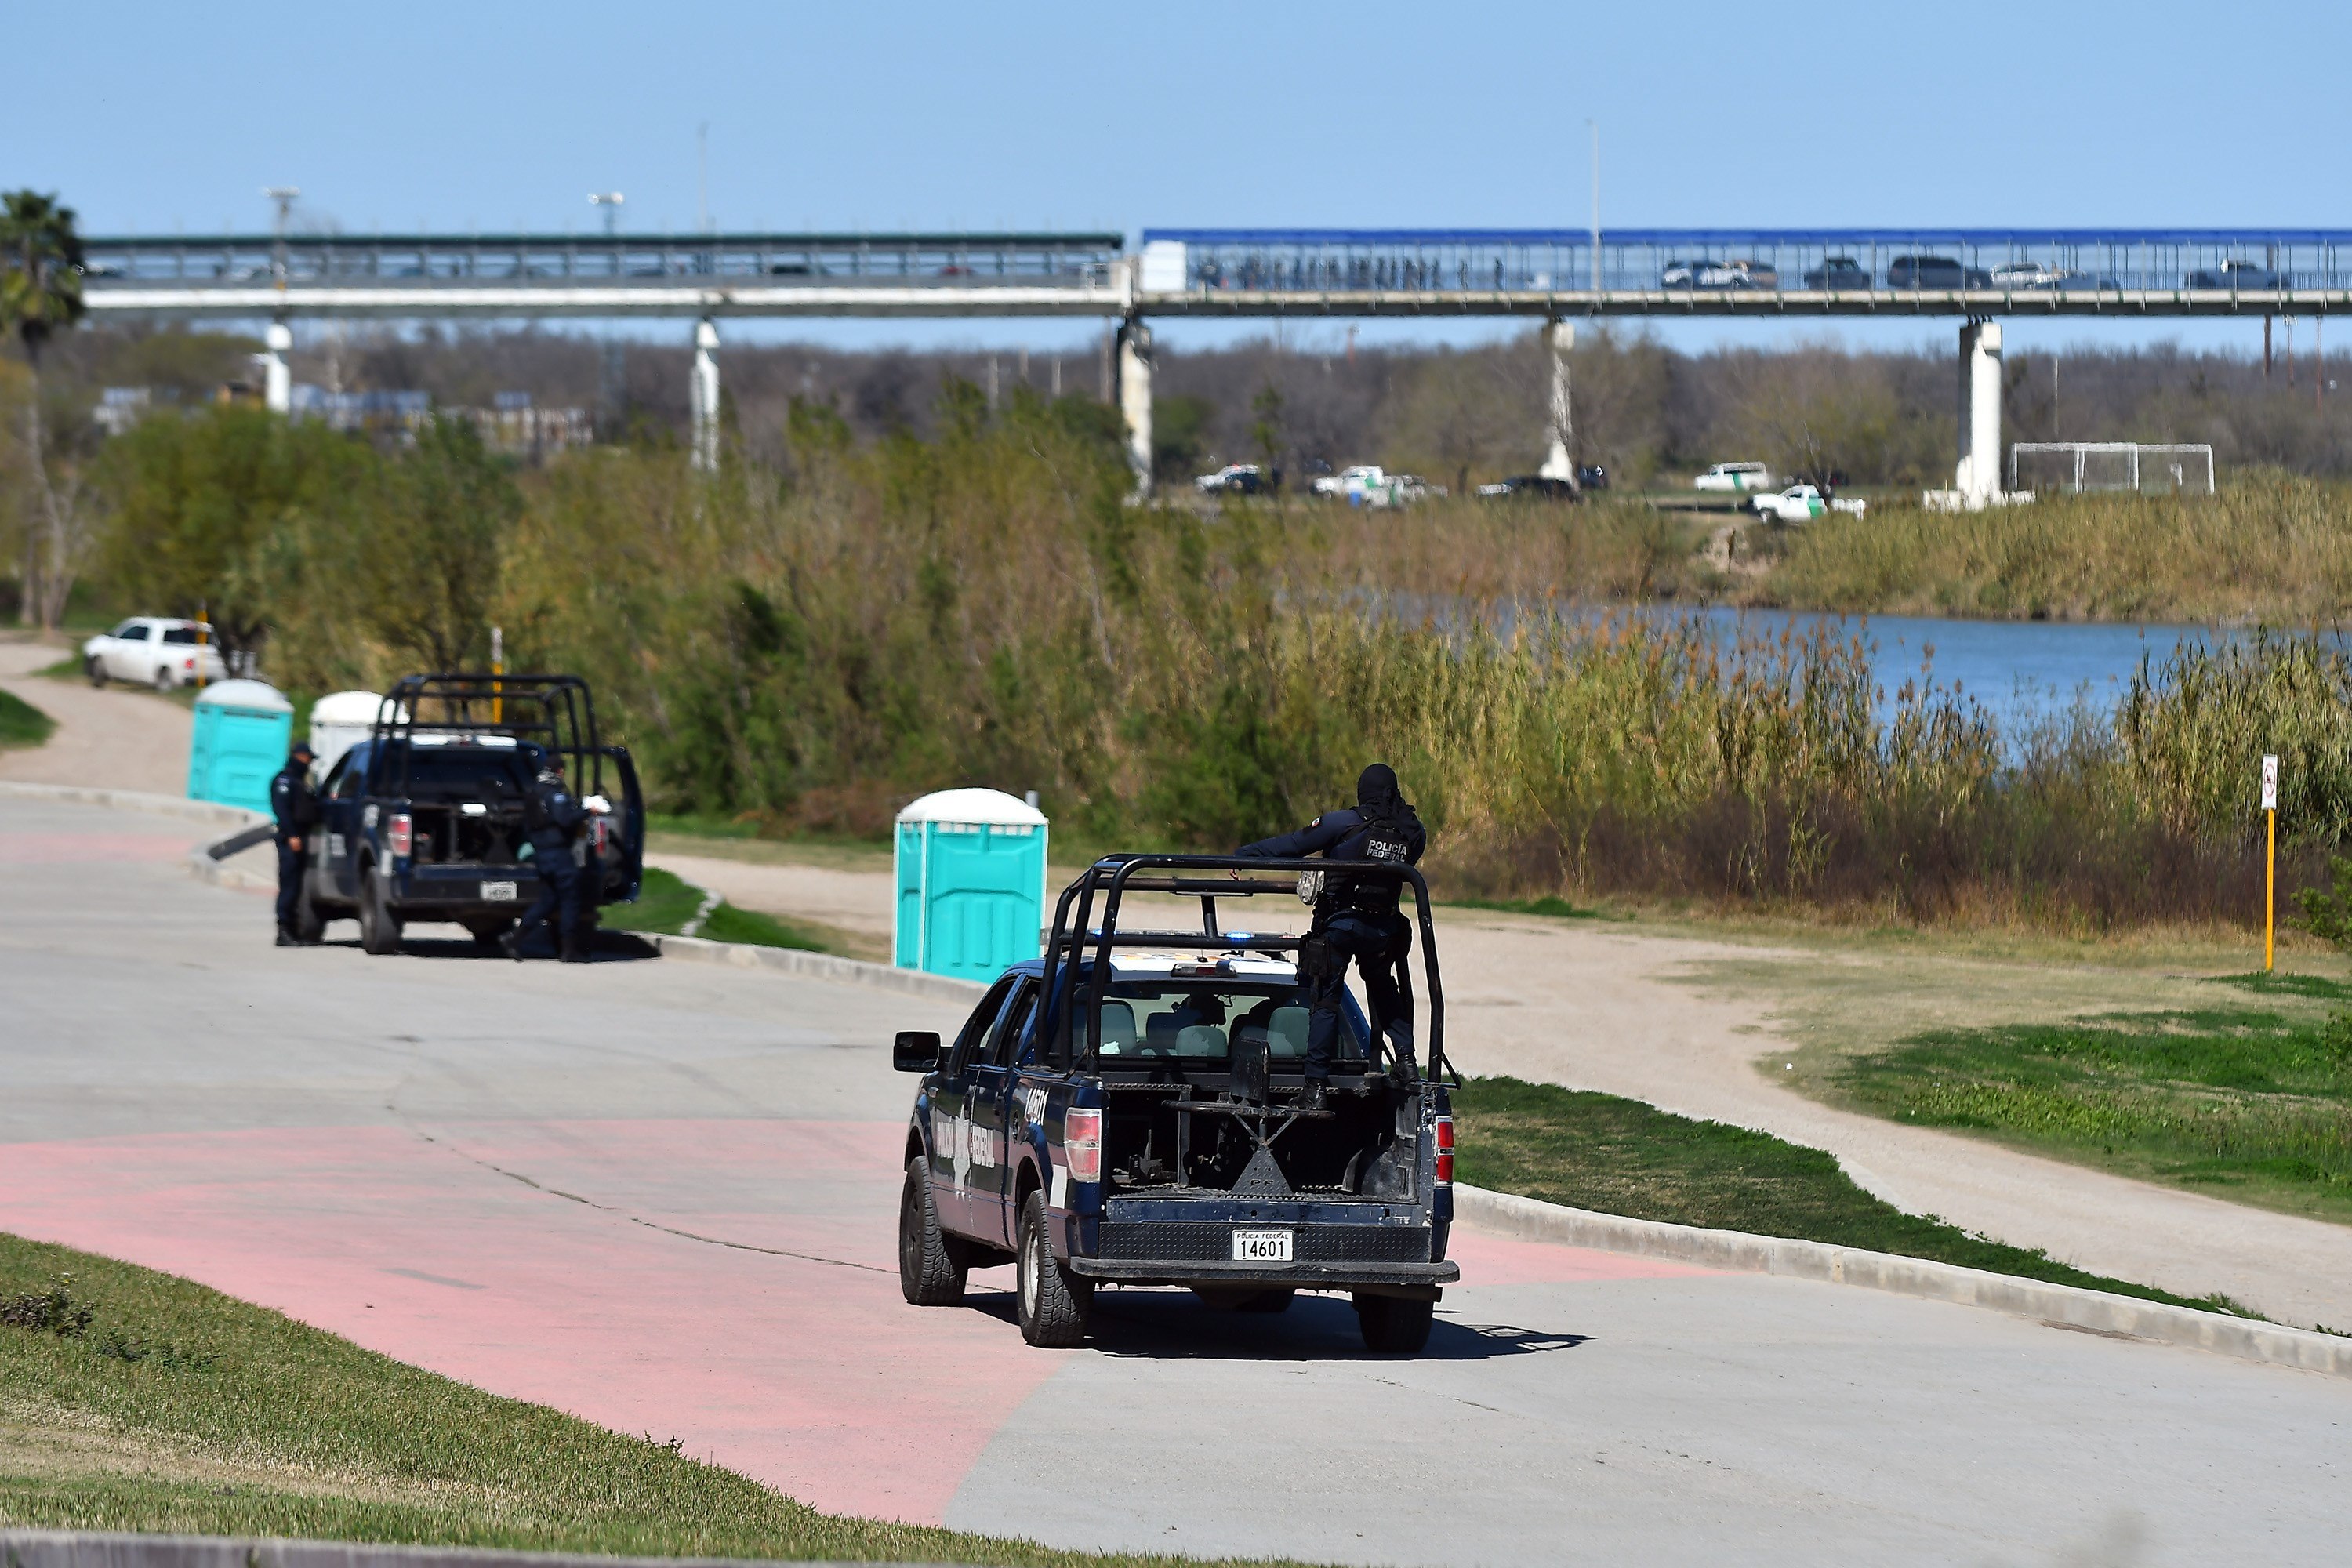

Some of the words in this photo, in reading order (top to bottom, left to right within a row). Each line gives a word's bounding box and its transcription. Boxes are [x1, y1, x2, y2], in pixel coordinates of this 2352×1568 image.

[1367, 848, 1405, 862] FEDERAL
[1369, 840, 1406, 855] POLICÍA
[1241, 1240, 1283, 1257] 14601
